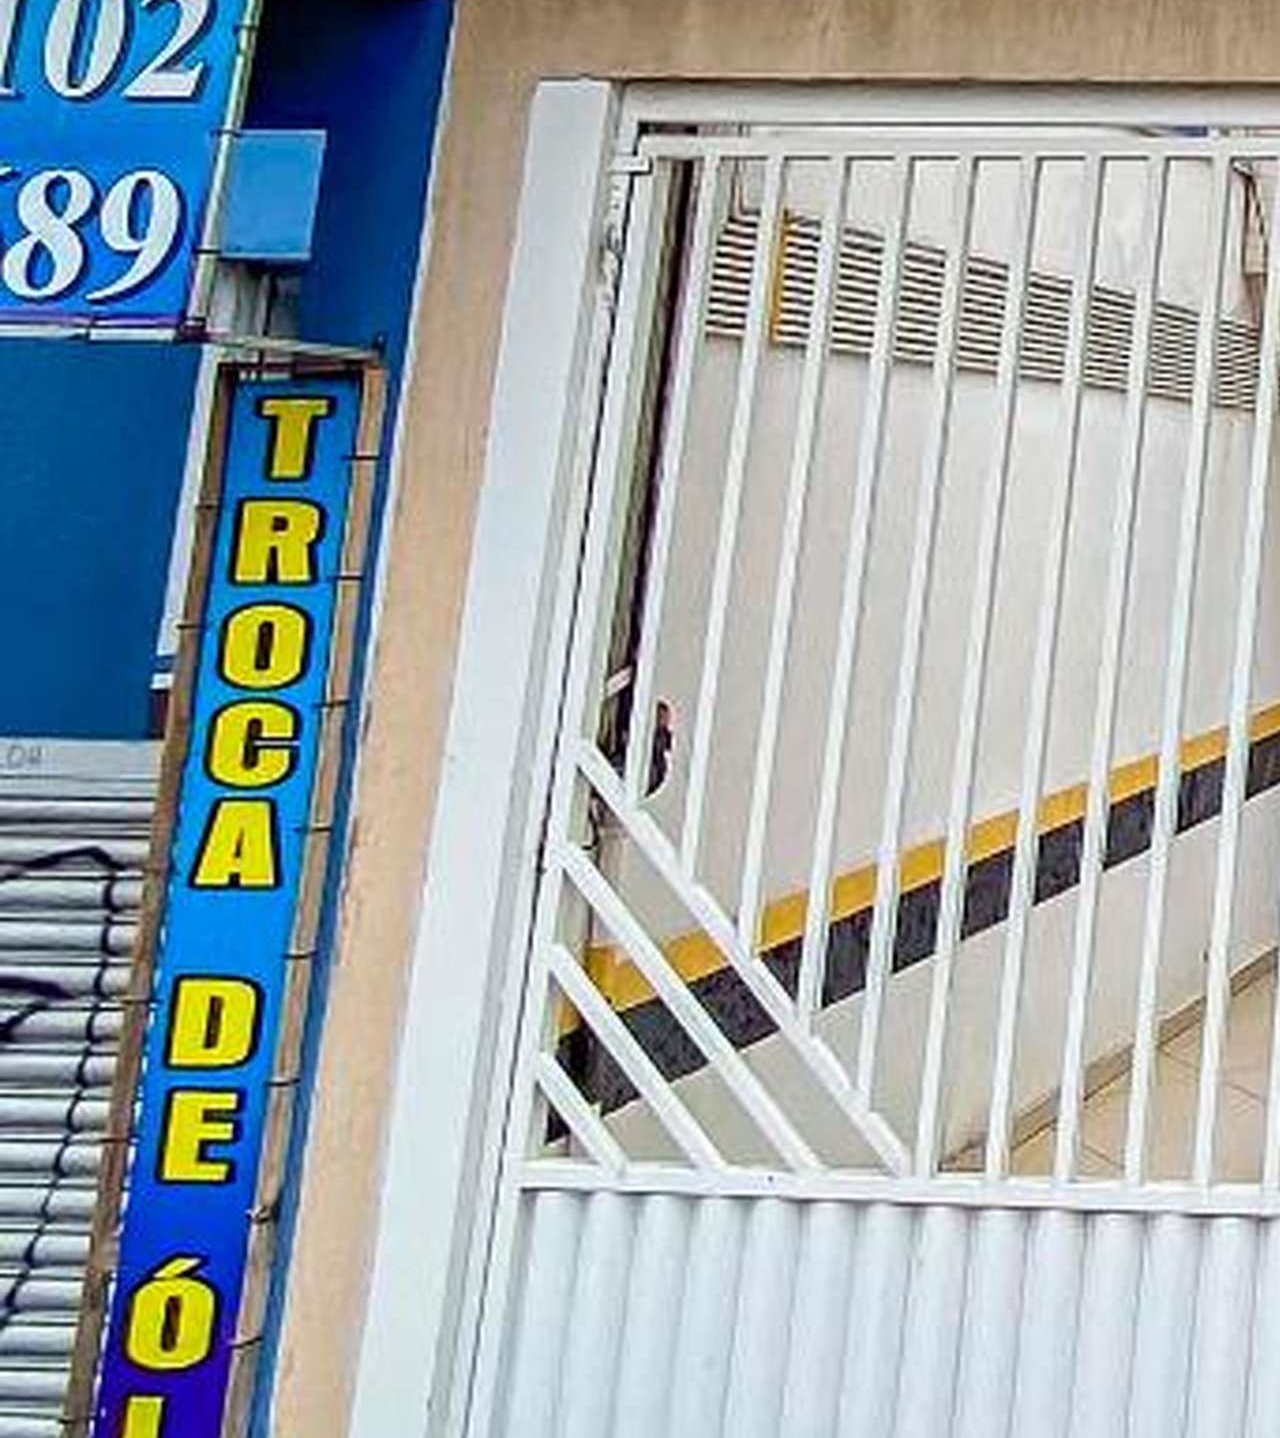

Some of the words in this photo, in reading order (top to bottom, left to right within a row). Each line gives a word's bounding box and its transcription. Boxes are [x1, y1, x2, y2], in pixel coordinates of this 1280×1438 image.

[0, 167, 181, 302] 89
[192, 397, 330, 888] TROCA
[161, 977, 258, 1183] DE
